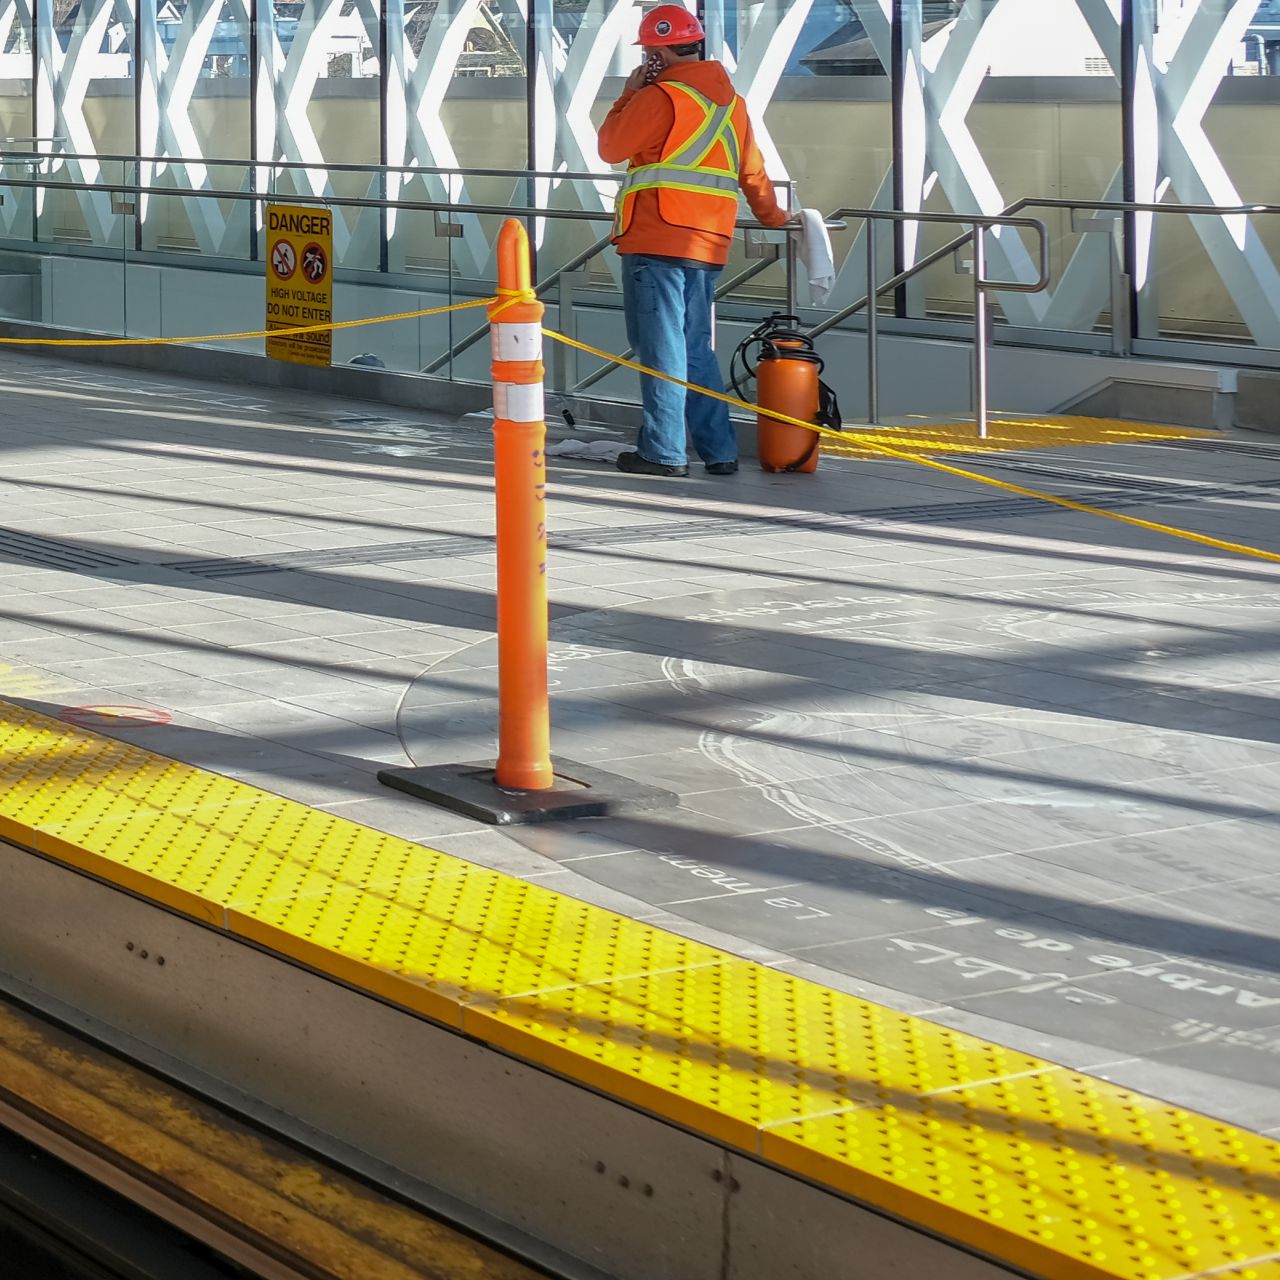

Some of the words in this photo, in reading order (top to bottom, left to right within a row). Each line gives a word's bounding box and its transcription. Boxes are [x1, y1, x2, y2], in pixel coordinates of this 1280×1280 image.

[268, 212, 330, 236] DANGER
[271, 287, 290, 299] HIGH
[291, 290, 328, 304] VOLTAGE
[267, 303, 280, 315] DO
[281, 304, 300, 317] NOT
[302, 307, 331, 322] ENTER
[305, 331, 330, 343] sound
[762, 896, 831, 920] La
[994, 927, 1074, 953] de
